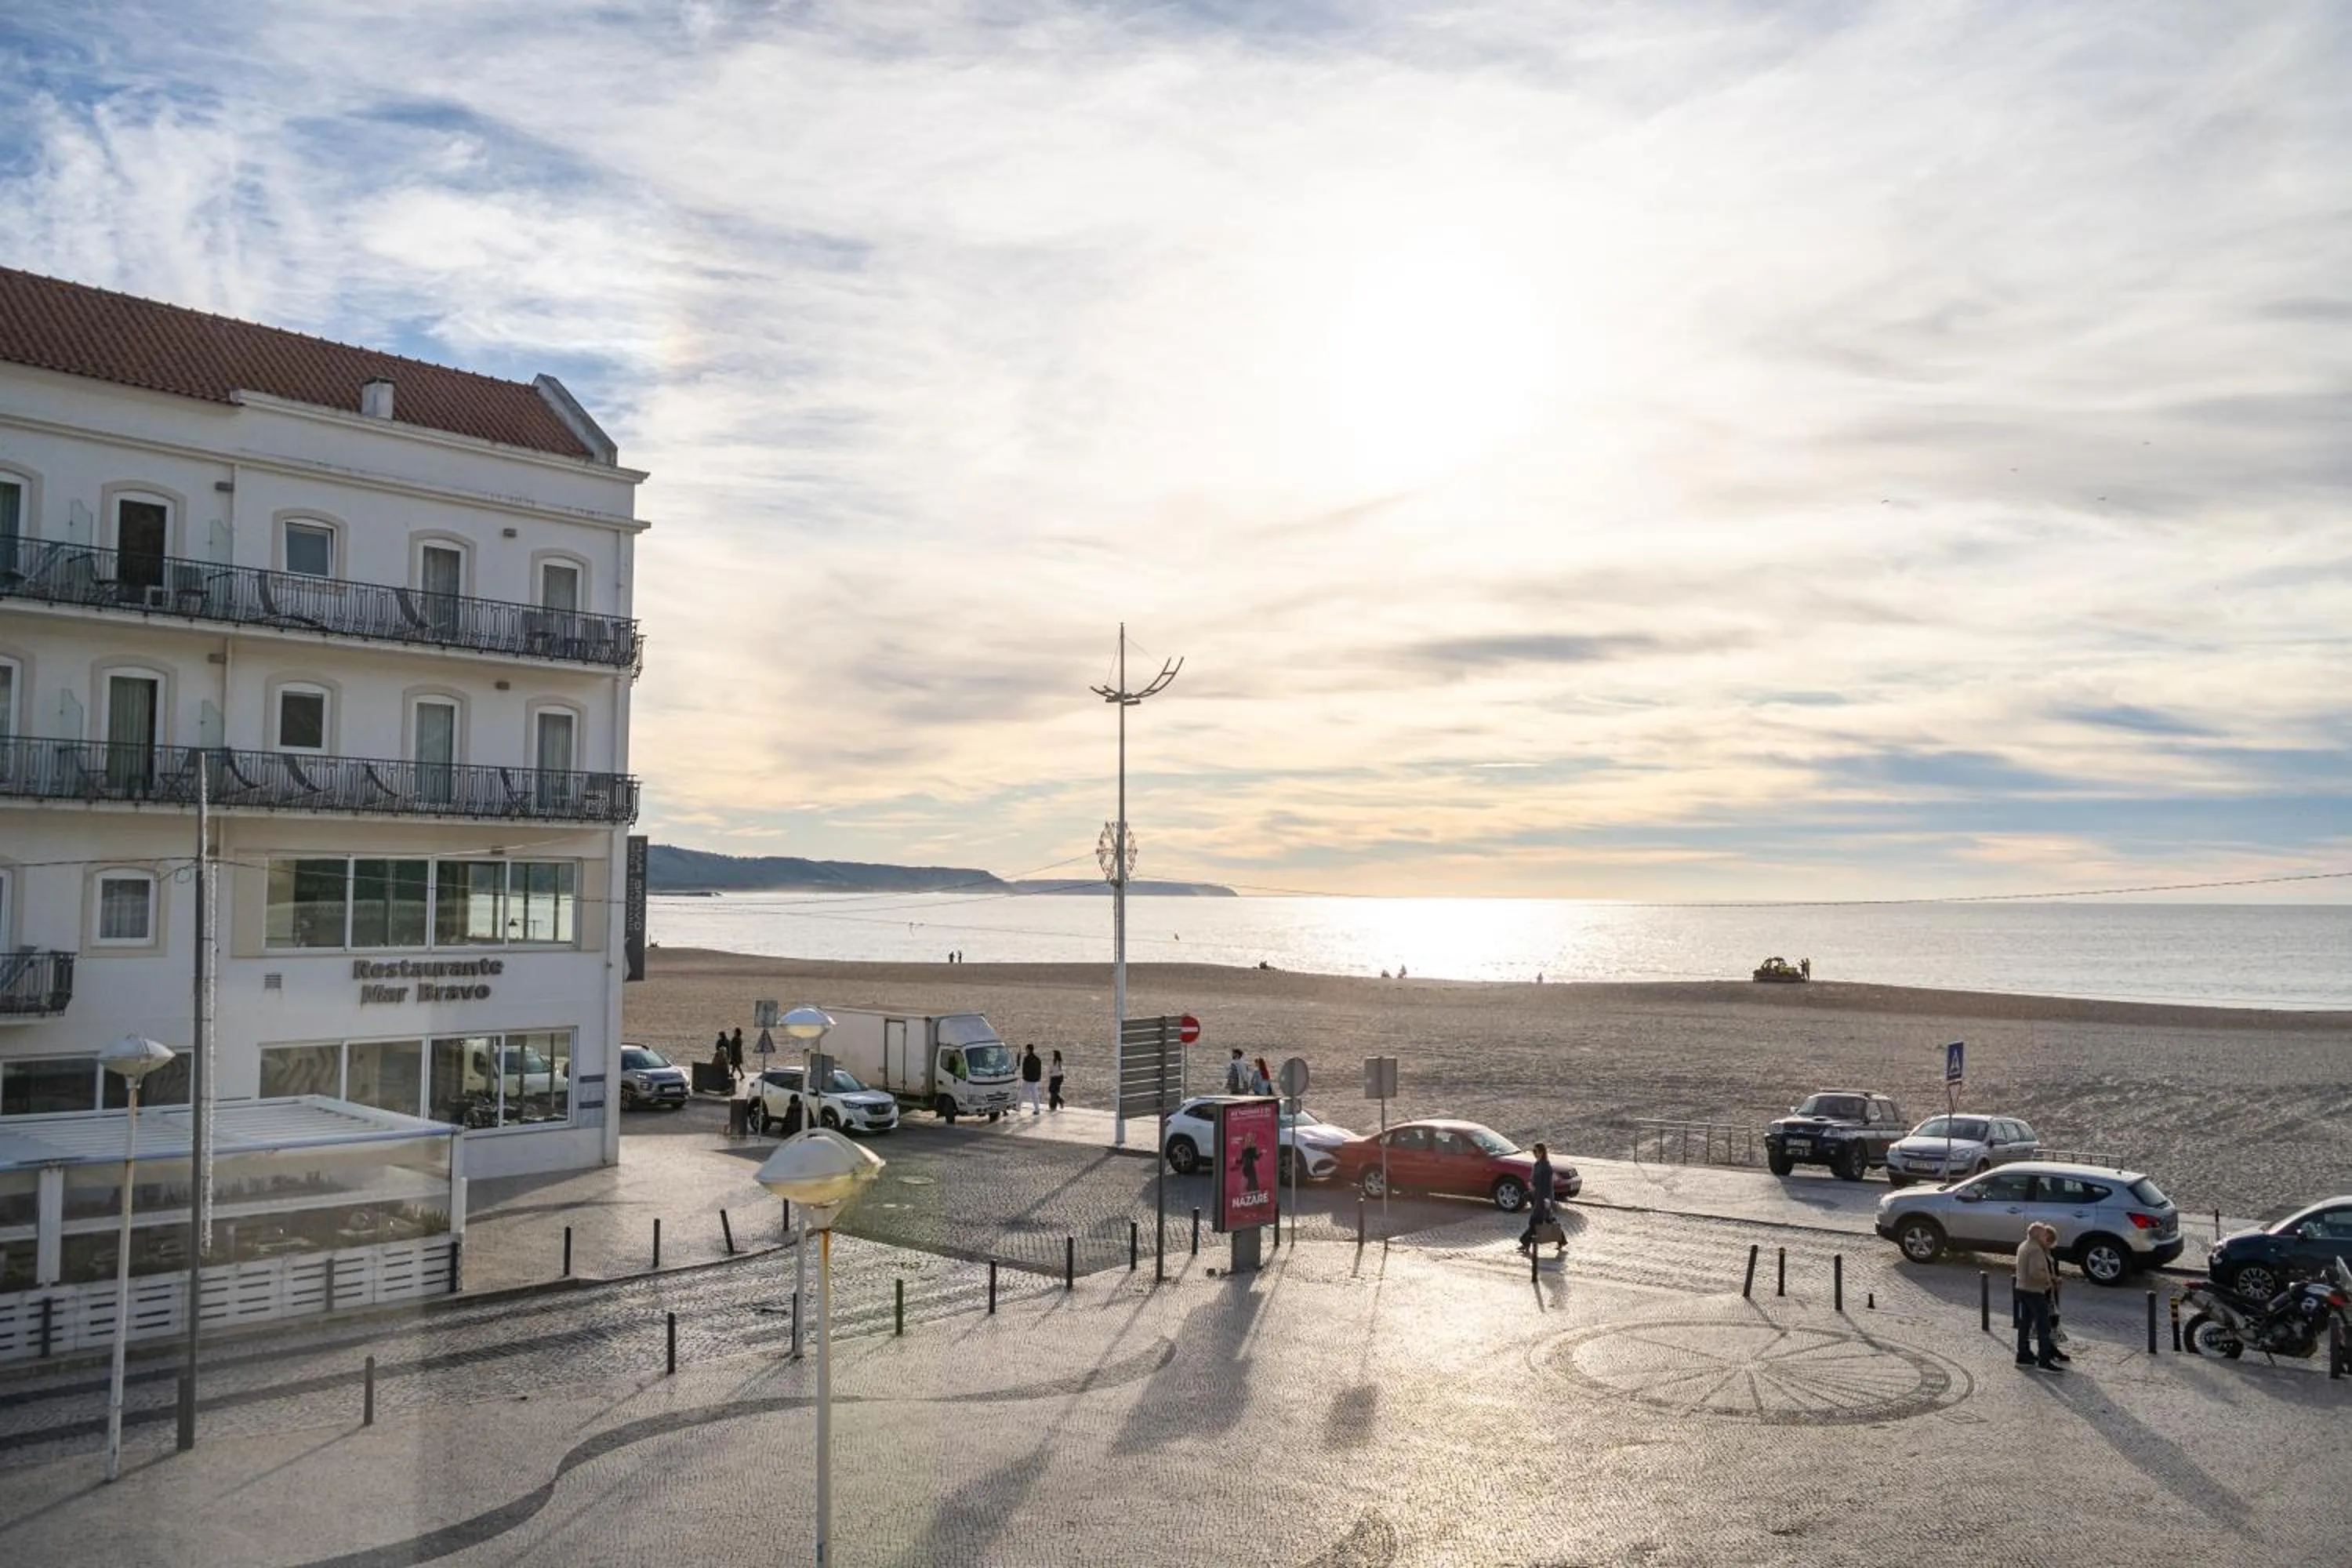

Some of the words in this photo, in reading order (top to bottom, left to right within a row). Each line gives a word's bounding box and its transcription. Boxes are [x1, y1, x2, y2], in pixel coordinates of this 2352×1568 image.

[354, 958, 504, 978] Restaurante
[361, 984, 409, 1006] Mar
[417, 982, 491, 1003] Bravo
